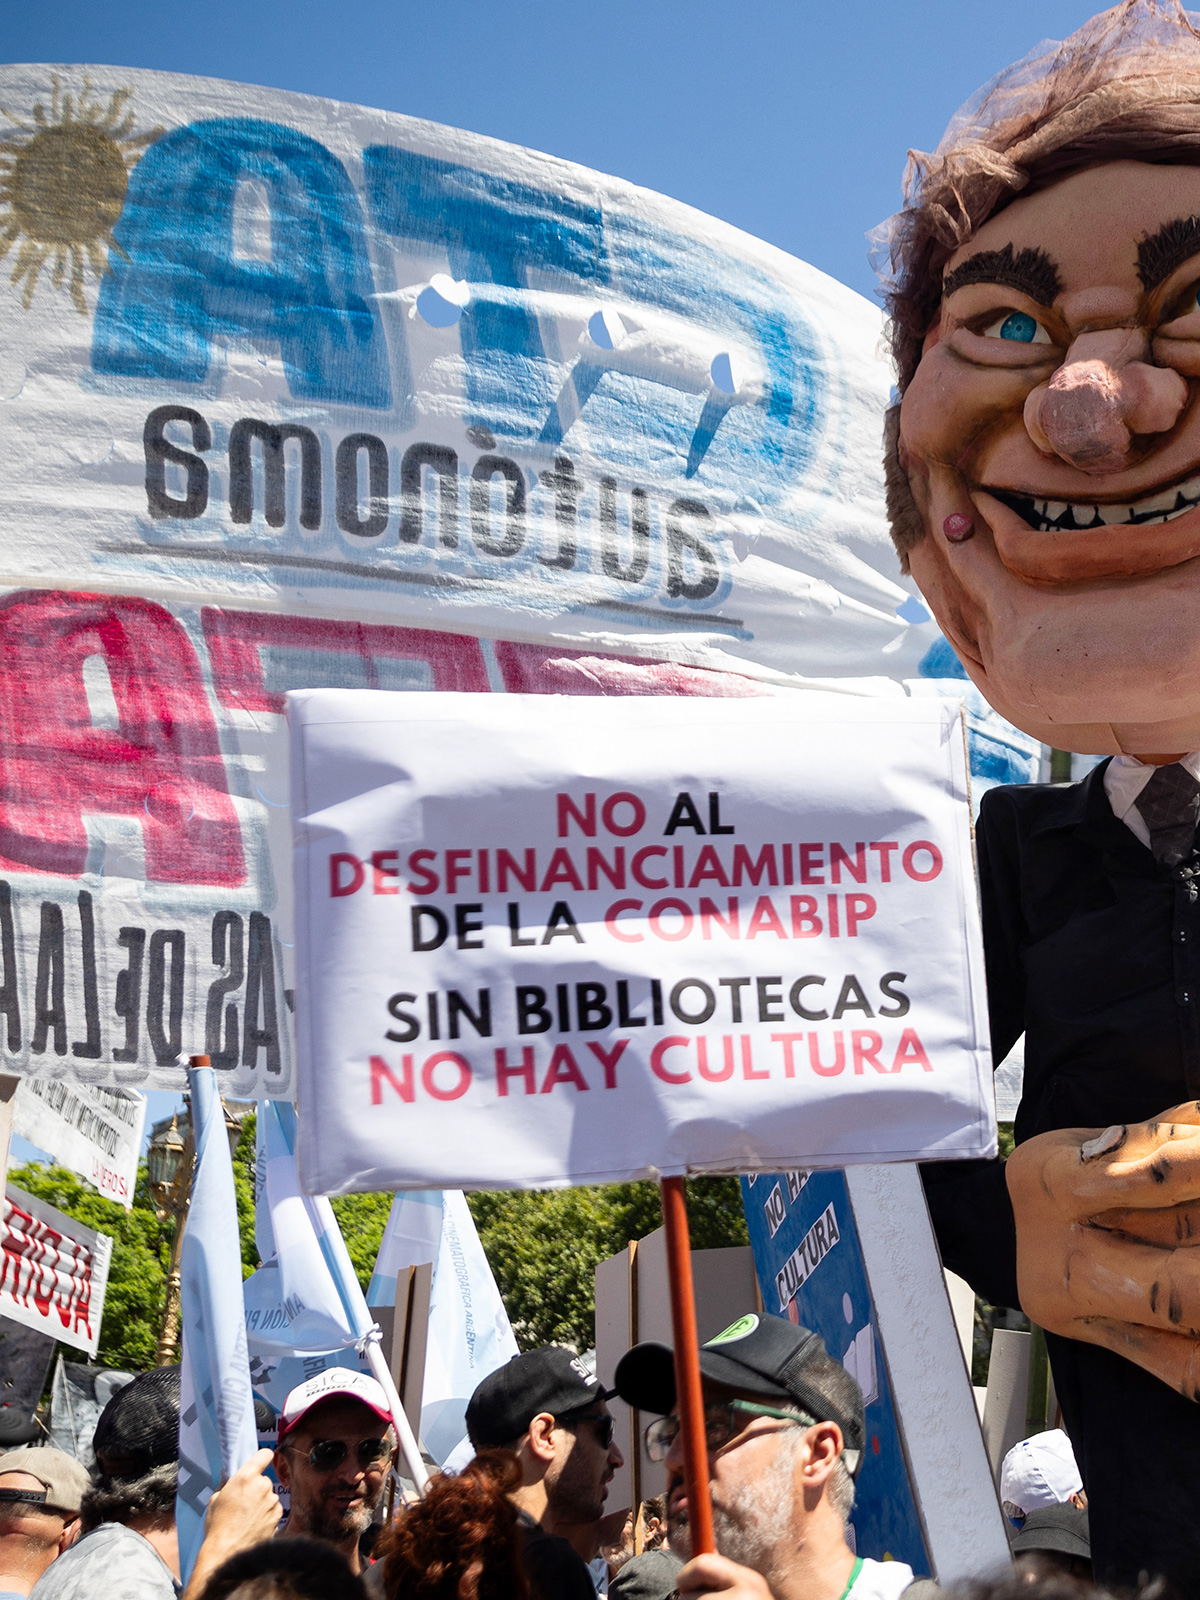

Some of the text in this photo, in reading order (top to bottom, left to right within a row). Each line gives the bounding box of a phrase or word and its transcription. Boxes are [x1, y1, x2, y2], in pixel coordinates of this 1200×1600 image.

[556, 791, 735, 837] NO AL
[329, 840, 944, 898] DESFINANCIAMIENTO
[410, 893, 878, 952] DE LA CONABIP
[384, 971, 911, 1043] SIN BIBLIOTECAS
[368, 1027, 934, 1105] NO HAY CULTURA
[766, 1187, 785, 1235] NO
[777, 1209, 840, 1307] CULTURA
[305, 1373, 367, 1392] SICA
